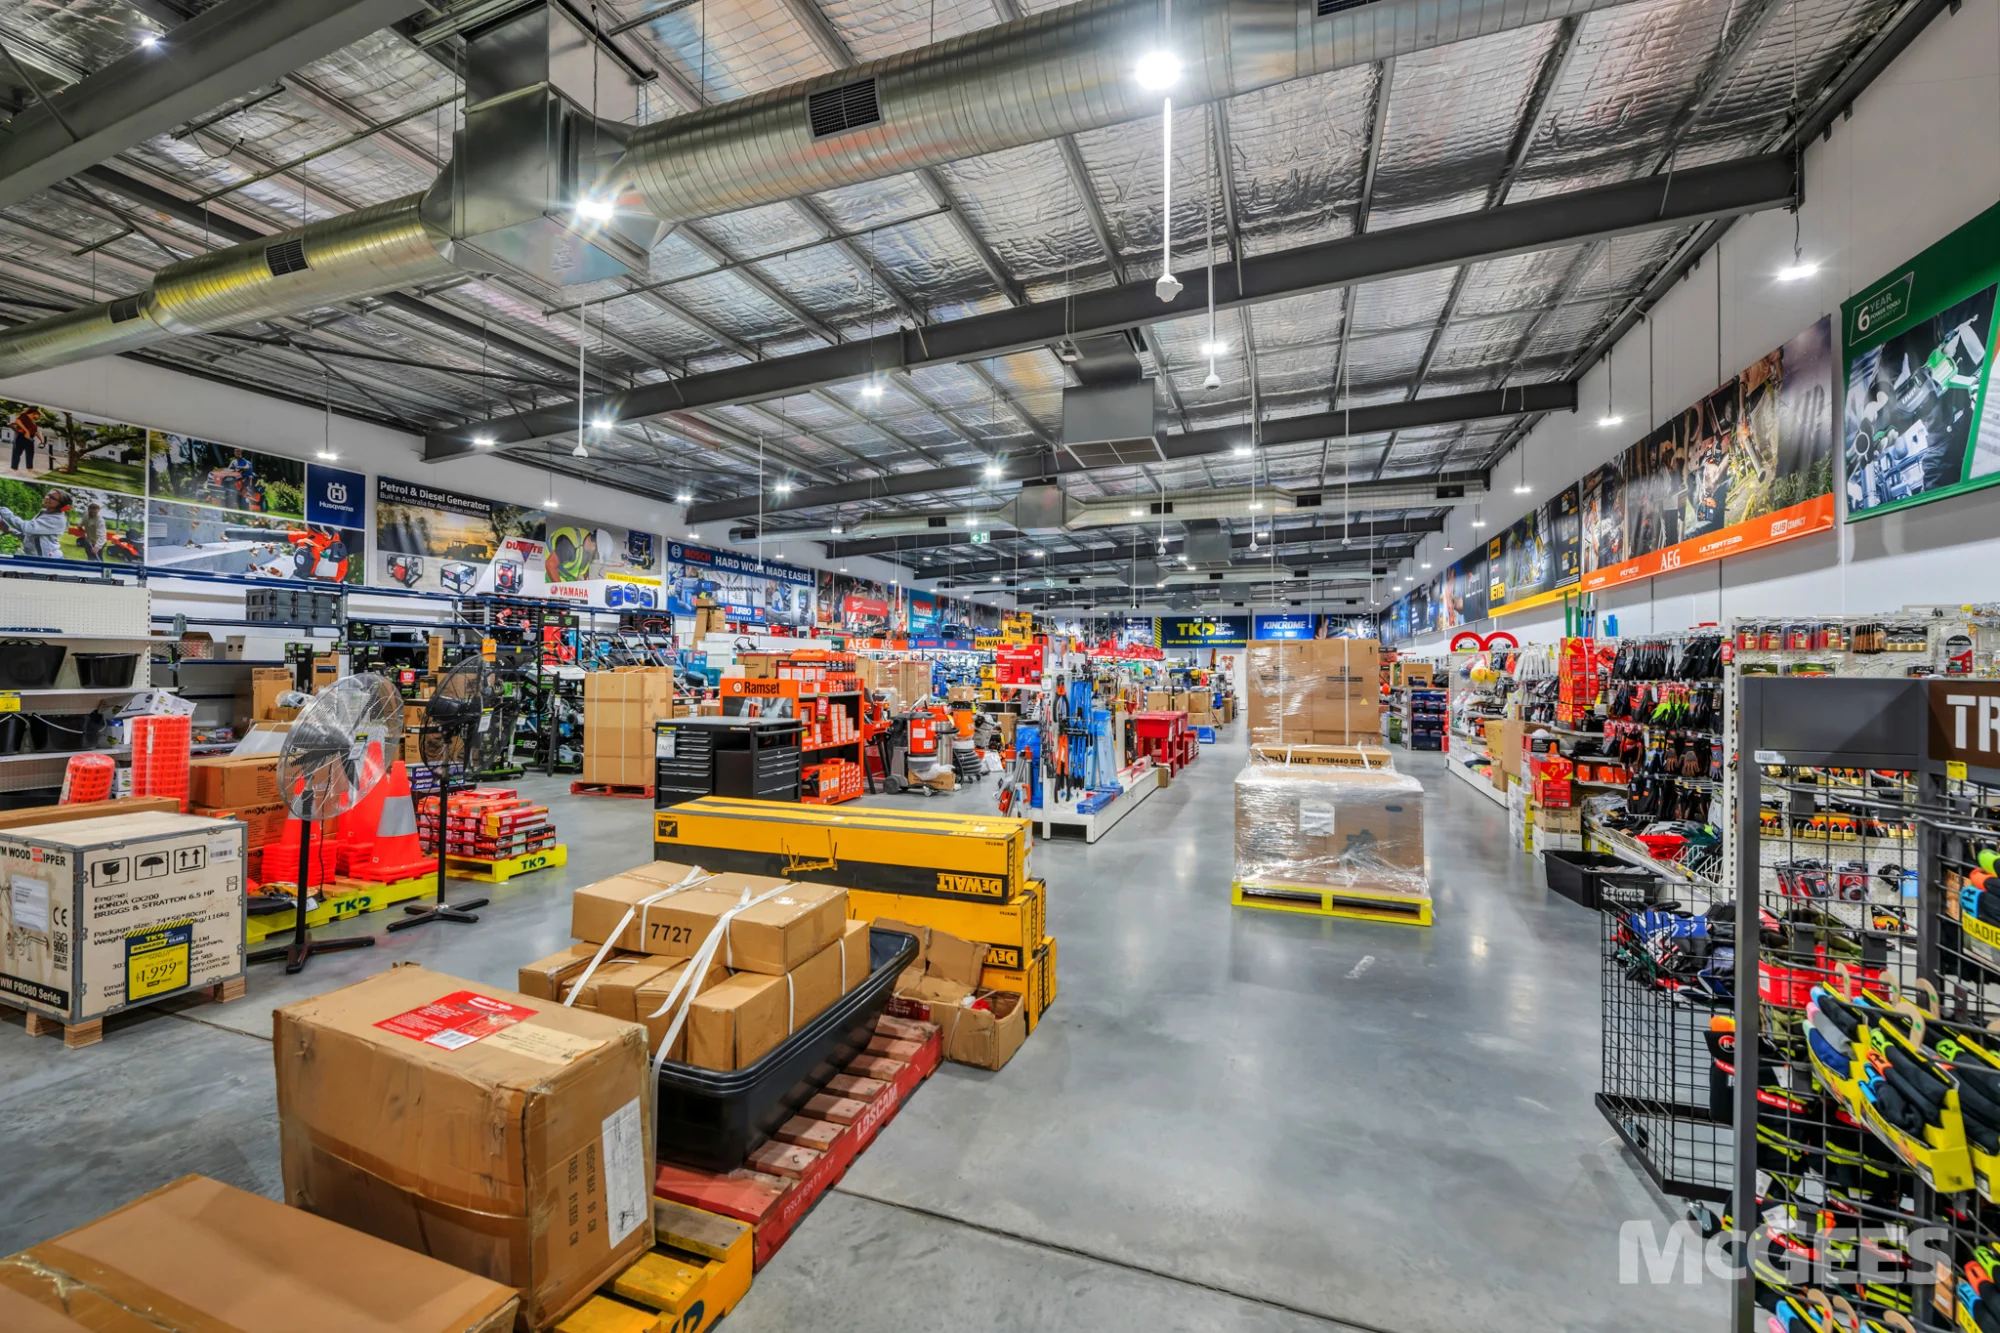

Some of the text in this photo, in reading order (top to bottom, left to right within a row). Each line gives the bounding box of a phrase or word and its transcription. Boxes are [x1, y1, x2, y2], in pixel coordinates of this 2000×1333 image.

[1858, 293, 1892, 331] 6 YEAR
[380, 481, 490, 512] Petrol & Diesel Generators
[380, 492, 394, 500] Built
[402, 496, 427, 507] Australia
[436, 503, 464, 514] Australian
[319, 500, 354, 512] Husqvarna
[1772, 521, 1787, 534] SUB
[684, 548, 711, 562] BOSCH
[1661, 549, 1680, 571] AEG
[715, 556, 740, 569] HARD
[766, 566, 787, 578] MADE
[558, 586, 589, 599] YAMAHA
[731, 606, 752, 616] TURBO
[1263, 621, 1306, 629] KINCROME
[847, 638, 870, 649] AEG
[881, 639, 893, 650] AEG
[744, 681, 780, 694] Ramset
[9, 848, 31, 860] WOOD
[43, 853, 66, 866] IPPER
[521, 856, 547, 870] TKD
[938, 874, 1001, 895] DEWALT
[93, 893, 160, 910] HONDA GX200
[93, 907, 130, 919] BRIGGS
[142, 896, 187, 909] STRATTON
[203, 889, 215, 897] HP
[94, 892, 129, 903] Engine:
[333, 896, 371, 914] TKD
[54, 931, 67, 941] ISO
[93, 926, 131, 938] Package
[133, 921, 153, 930] size:
[650, 922, 693, 945] 7727
[38, 988, 62, 1004] Series
[856, 1082, 898, 1142] LOSCAM
[568, 1154, 578, 1185] TABLE
[587, 1218, 597, 1234] CM
[569, 1231, 579, 1247] CM
